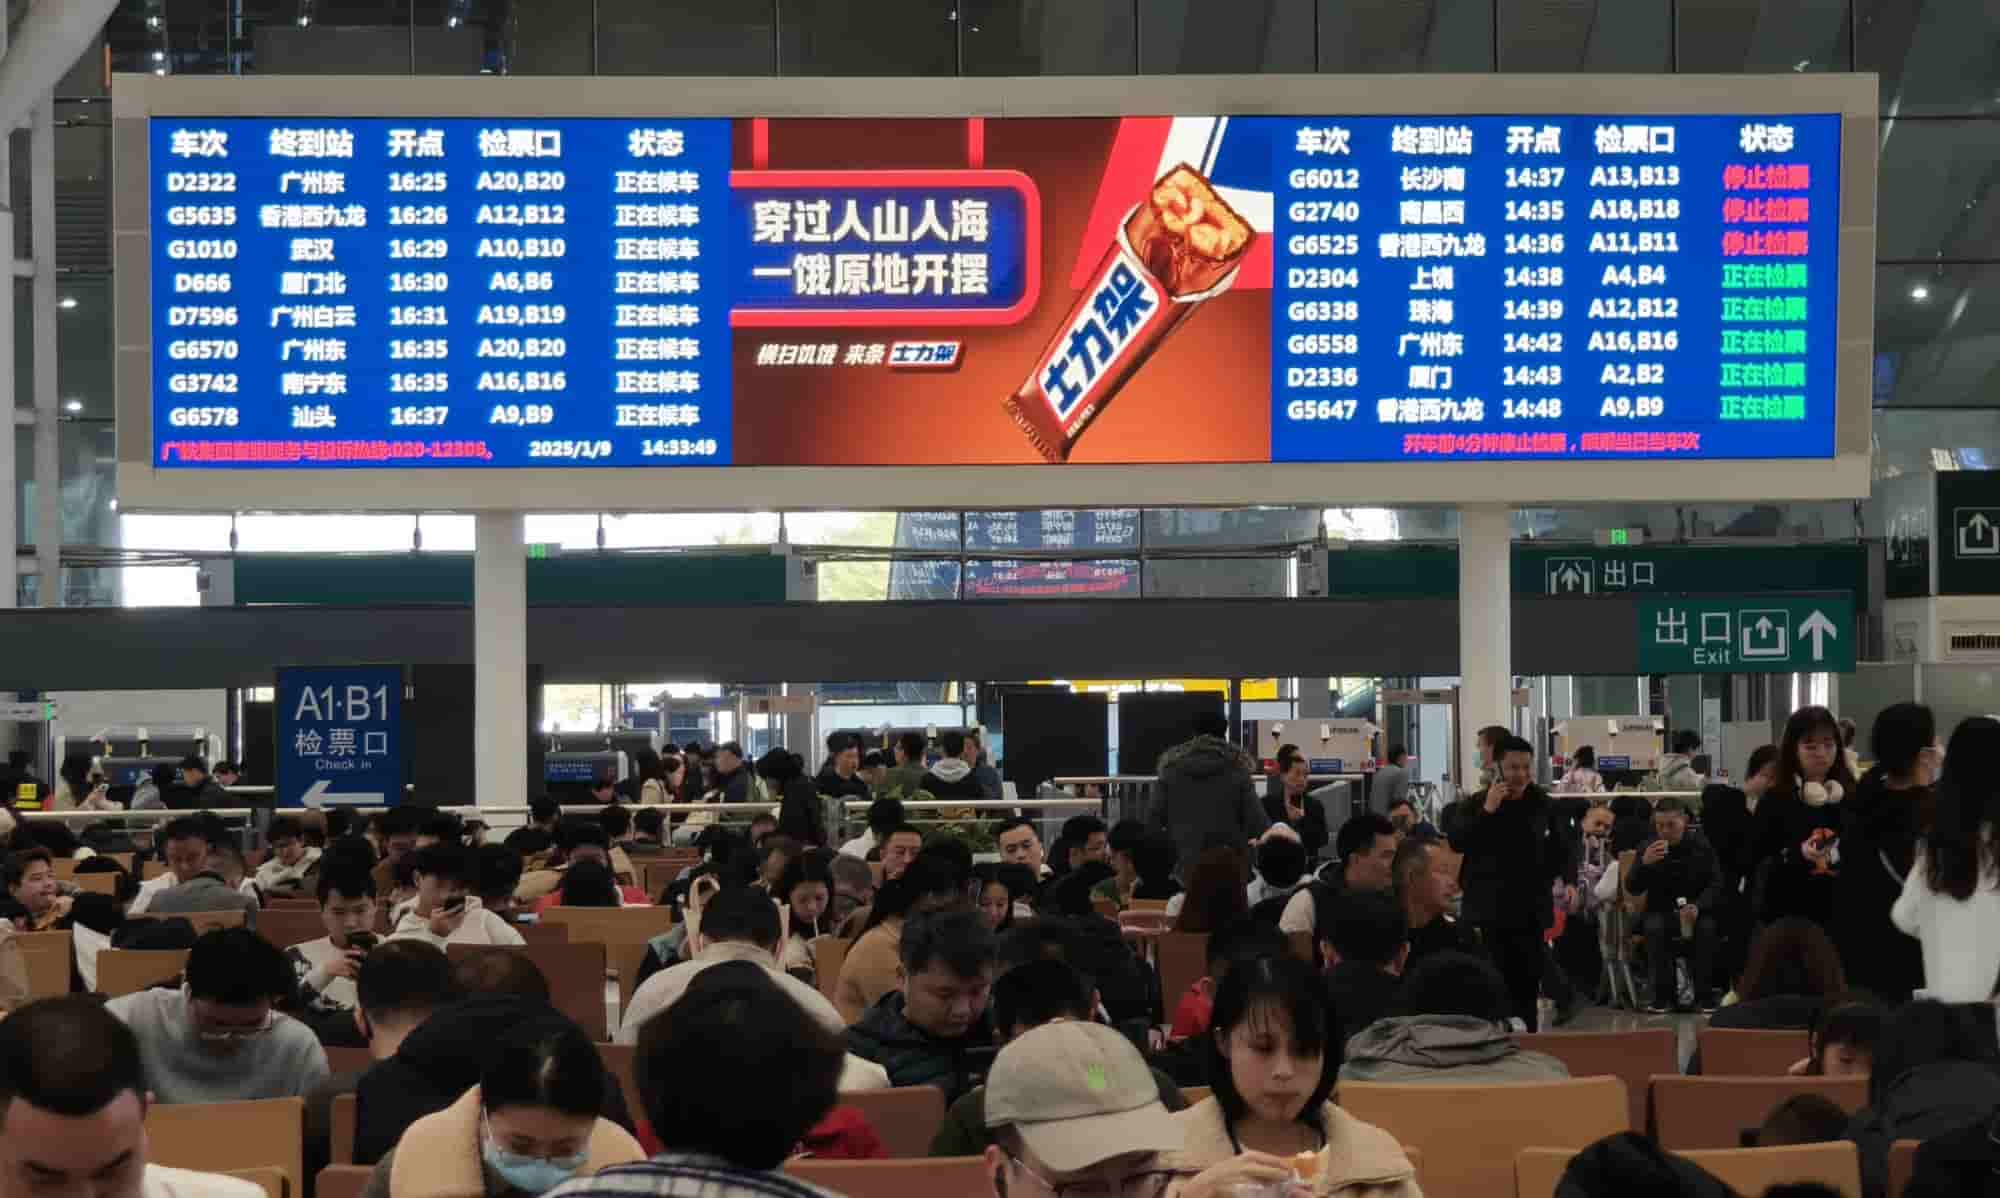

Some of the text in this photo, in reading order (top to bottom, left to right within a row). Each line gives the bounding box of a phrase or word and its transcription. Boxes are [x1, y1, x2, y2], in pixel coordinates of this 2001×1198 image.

[171, 128, 684, 158] 车次 终到站 开点 检票口 状态
[1296, 124, 1794, 155] 车次 终到站 开点 检票口 状态
[168, 170, 699, 194] D2322 广州东 16:25 A20,B20 正在候车
[1290, 165, 1809, 191] G6012 长沙南 14:37 A13,B13 停止检票
[167, 204, 699, 227] G5635 香港西九龙 16:26 A12,B12 正在候车
[753, 199, 989, 243] 穿过人山人海
[1289, 198, 1809, 224] G2740 南昌西 14:35 A18,B18 停止检票
[167, 237, 699, 261] G1010 武汉 16:29 A10,B10 正在候车
[1289, 231, 1808, 258] G6525 香港西九龙 14:36 A11,B11 停止检票
[175, 270, 699, 294] D666 厦门北 16:30 A6,B6 正在候车
[752, 252, 988, 296] 一饿原地开摆
[1288, 268, 1358, 288] D2304
[1504, 266, 1563, 286] 14:38
[1602, 265, 1666, 287] A4,B4
[1722, 264, 1808, 288] 正在检票
[168, 304, 699, 328] D7596 广州白云 16:31 A19,B19 正在候车
[1288, 296, 1807, 324] G6338 珠海 14:39 A12,B12 正在检票
[168, 337, 700, 361] G6570 广州东 16:35 A20,B20 正在候车
[1045, 262, 1153, 413] 士力架
[1288, 329, 1806, 357] G6558 广州东 14:42 A16,B16 正在检票
[757, 343, 956, 366] 横扫饥饿 来条 士力架
[169, 370, 700, 395] G3742 南宁东 16:35 A16,B16 正在候车
[1288, 362, 1806, 389] D2336 厦门 14:43 A2,B2 正在检票
[169, 404, 700, 428] G6578 汕头 16:37 A9,B9 正在候车
[1288, 395, 1805, 422] G5647 香港西九龙 14:48 A9,B9 正在检票
[529, 439, 717, 459] 2025/1/9 14:33:49
[1604, 560, 1654, 586] 出口
[1655, 608, 1731, 645] 出口
[1694, 648, 1731, 664] Exit
[295, 728, 388, 756] 检票口
[315, 759, 372, 769] Check in
